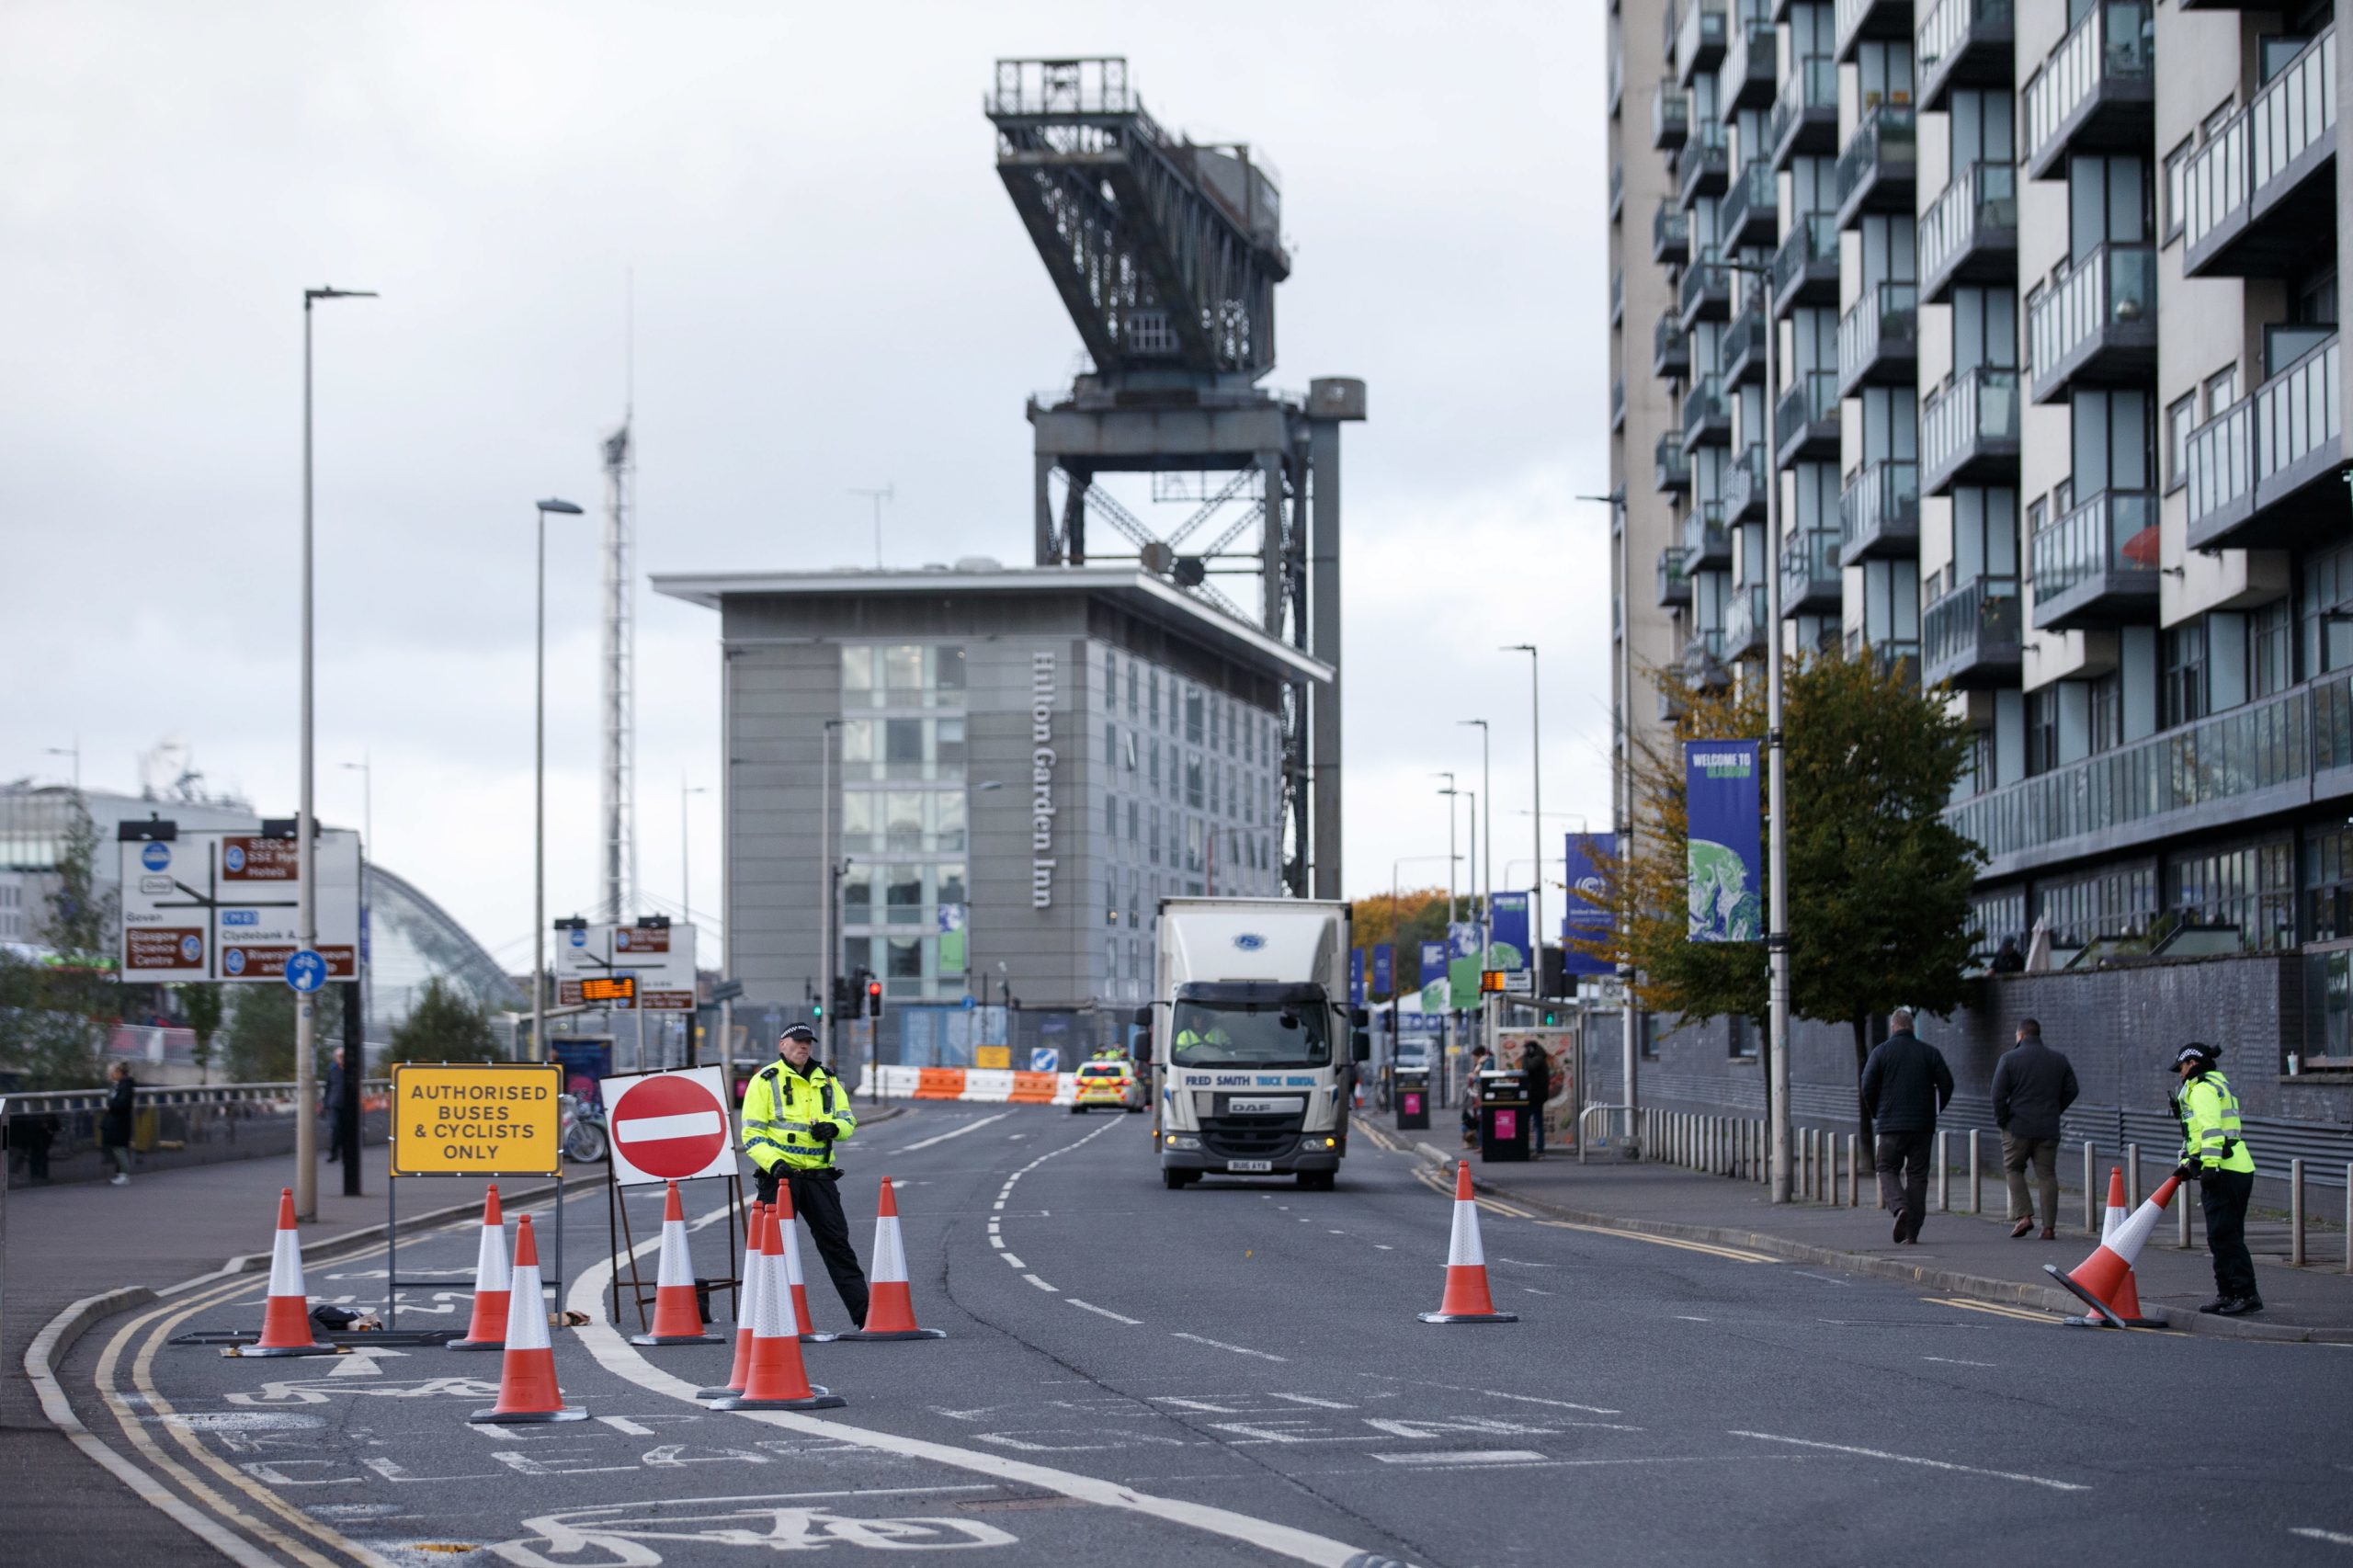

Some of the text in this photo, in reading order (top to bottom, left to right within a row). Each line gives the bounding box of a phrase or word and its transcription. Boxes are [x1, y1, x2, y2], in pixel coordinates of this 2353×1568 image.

[1033, 652, 1056, 908] Hilton Garden Inn
[1186, 1076, 1211, 1085] FRED
[1216, 1076, 1250, 1086] SMITH
[411, 1085, 548, 1100] AUTHORISED
[438, 1106, 509, 1120] BUSES
[415, 1124, 534, 1138] & CYCLISTS
[443, 1145, 498, 1159] ONLY
